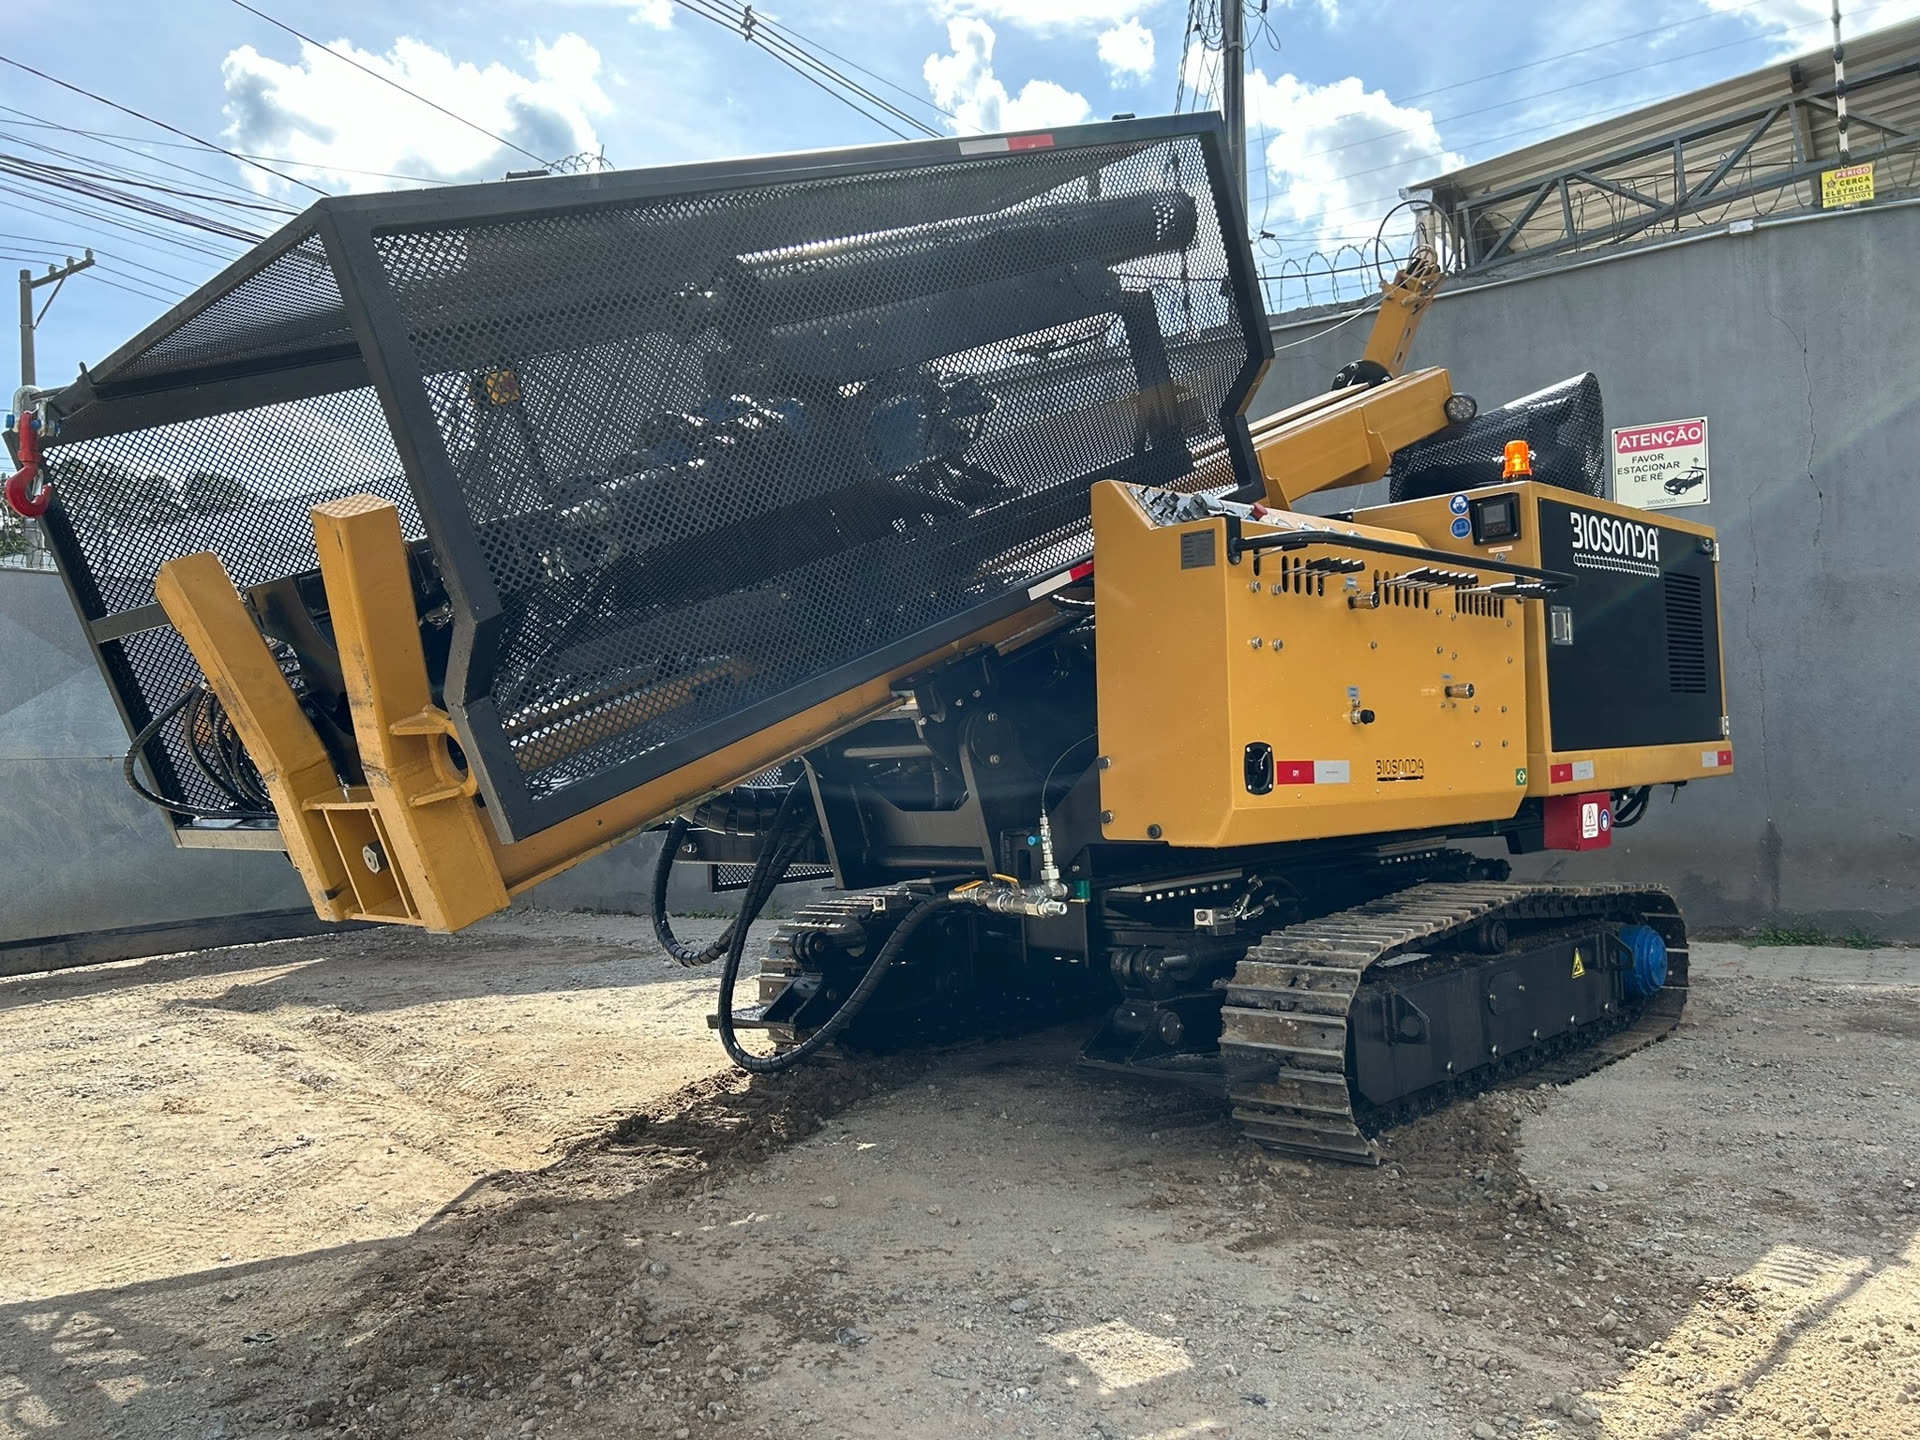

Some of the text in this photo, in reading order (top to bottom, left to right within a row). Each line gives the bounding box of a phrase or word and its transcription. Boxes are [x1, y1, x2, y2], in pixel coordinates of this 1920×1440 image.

[1836, 167, 1869, 178] PERIGO
[1840, 176, 1870, 186] CERCA
[1619, 426, 1700, 449] ATENÇÃO
[1631, 453, 1664, 464] FAVOR
[1617, 461, 1680, 475] ESTACIONAR
[1650, 472, 1663, 481] RÉ
[1570, 512, 1659, 562] BIOSONDA
[1376, 758, 1424, 775] BIOSONDA
